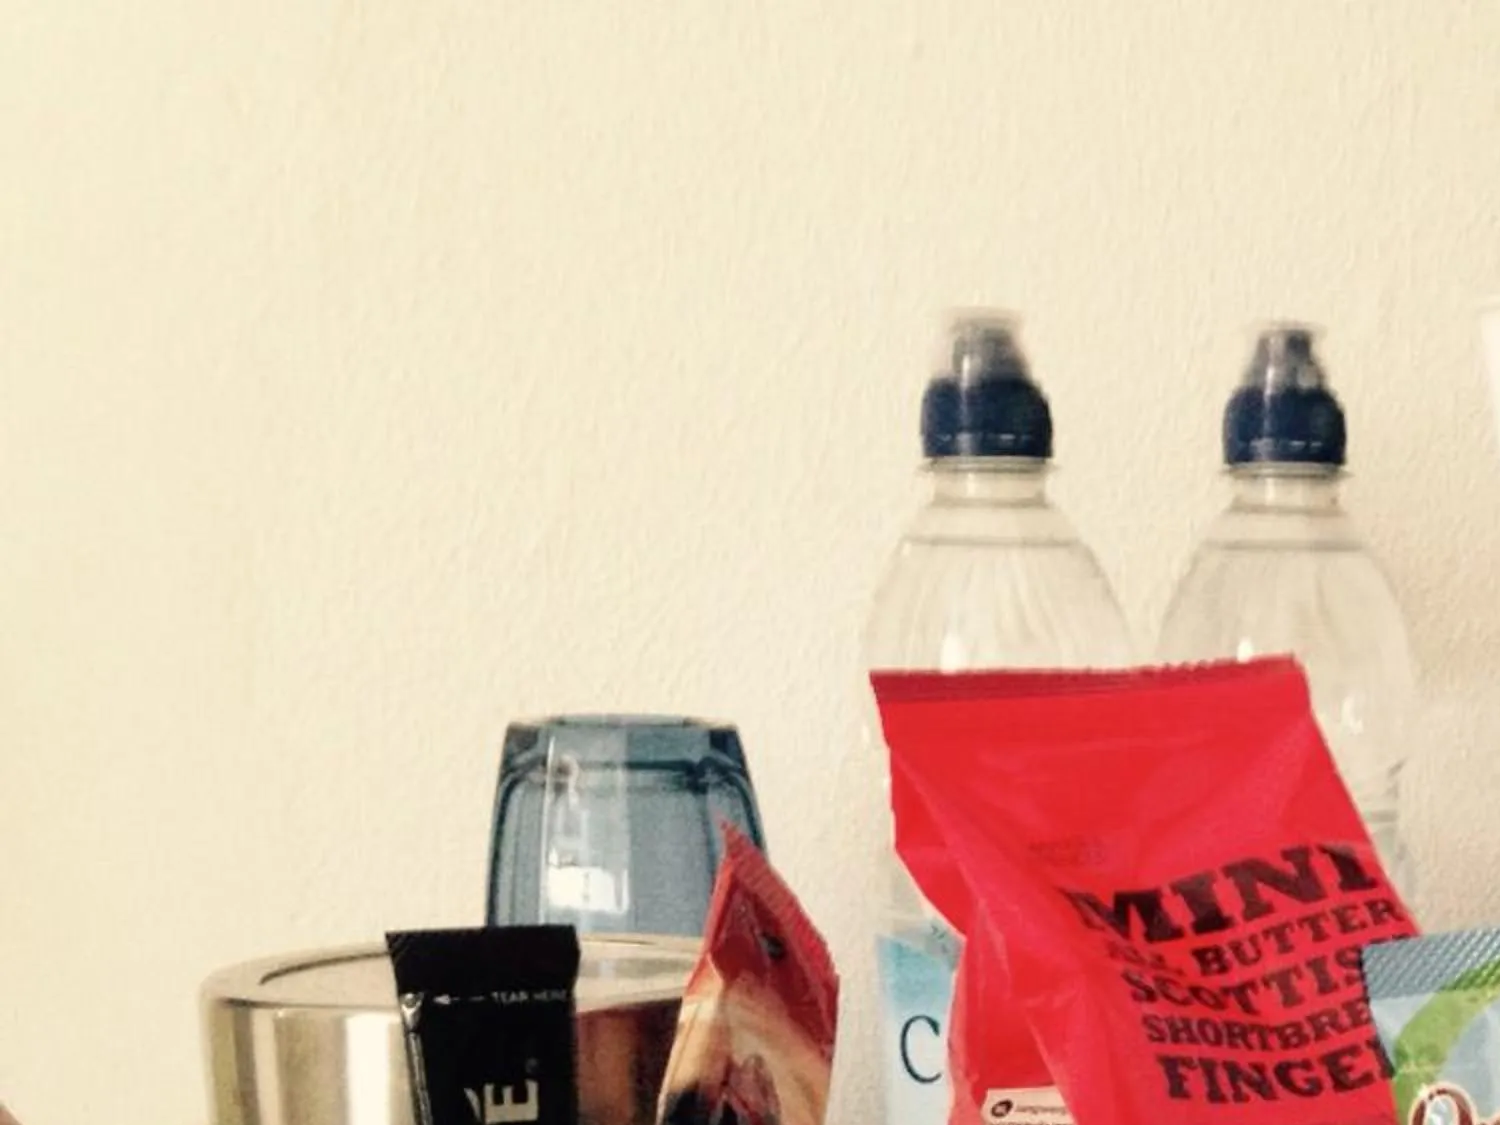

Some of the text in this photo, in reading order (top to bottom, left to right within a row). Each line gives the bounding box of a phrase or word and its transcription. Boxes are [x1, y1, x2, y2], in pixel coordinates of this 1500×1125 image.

[1058, 842, 1378, 944] MINI
[1121, 933, 1406, 1016] SCOTTIS
[1190, 898, 1405, 978] BUTTER
